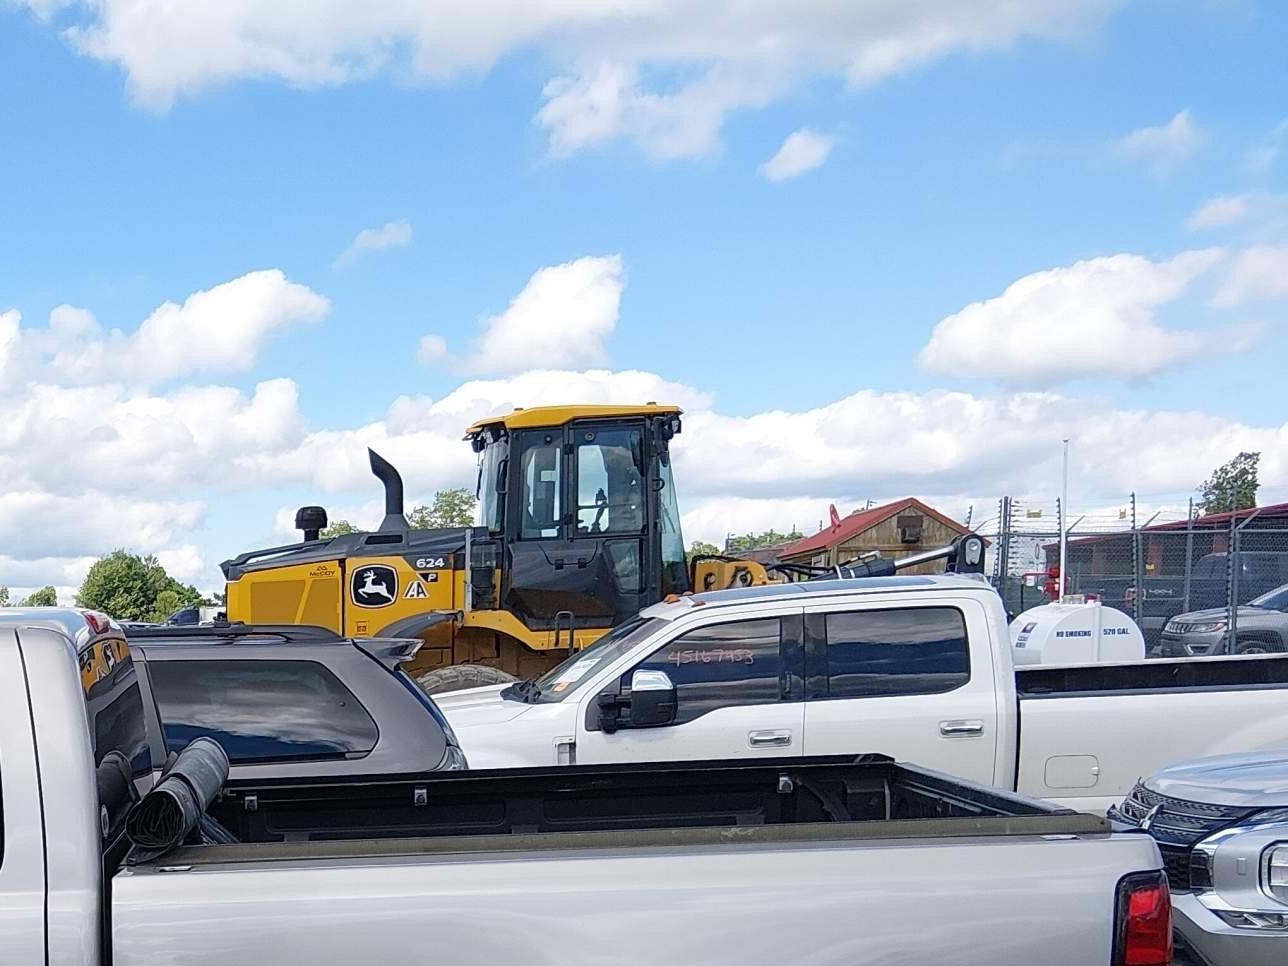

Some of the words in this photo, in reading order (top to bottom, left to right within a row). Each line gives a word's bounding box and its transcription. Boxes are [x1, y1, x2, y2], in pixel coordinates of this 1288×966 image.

[416, 558, 445, 568] 624
[427, 573, 437, 582] P
[1065, 630, 1092, 638] SMOKING
[1103, 628, 1116, 636] 520
